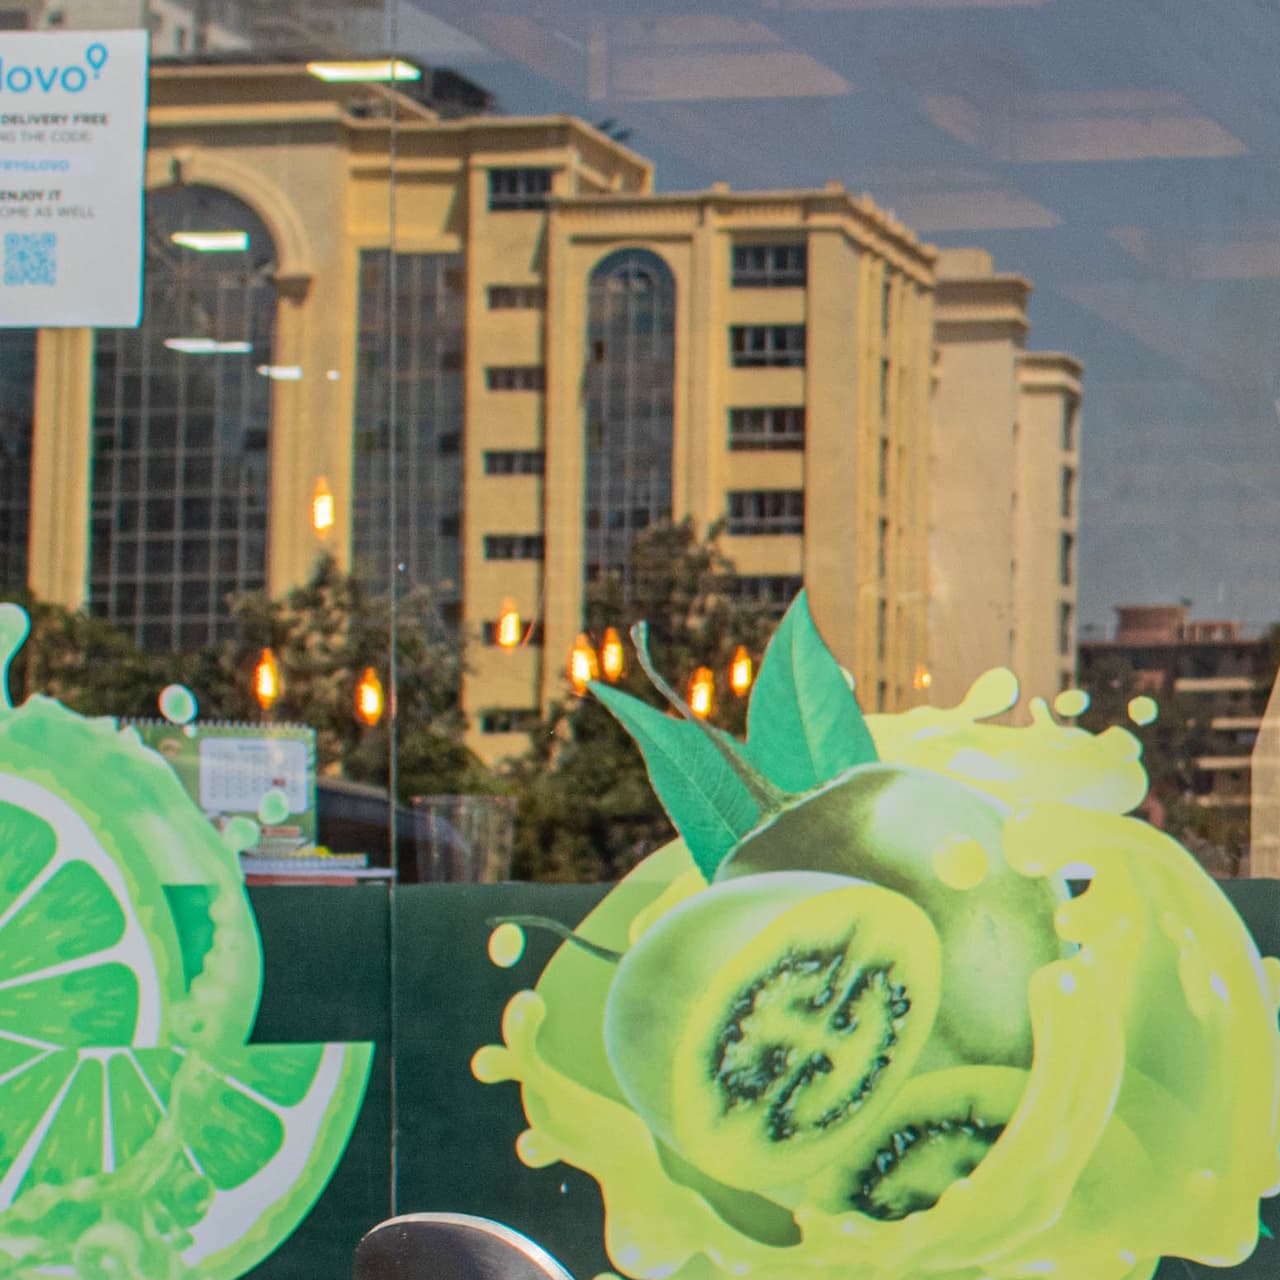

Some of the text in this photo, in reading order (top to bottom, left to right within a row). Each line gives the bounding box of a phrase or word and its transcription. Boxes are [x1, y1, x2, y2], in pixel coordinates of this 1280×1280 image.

[1, 113, 108, 125] DELIVERY FREE
[20, 130, 44, 143] THE
